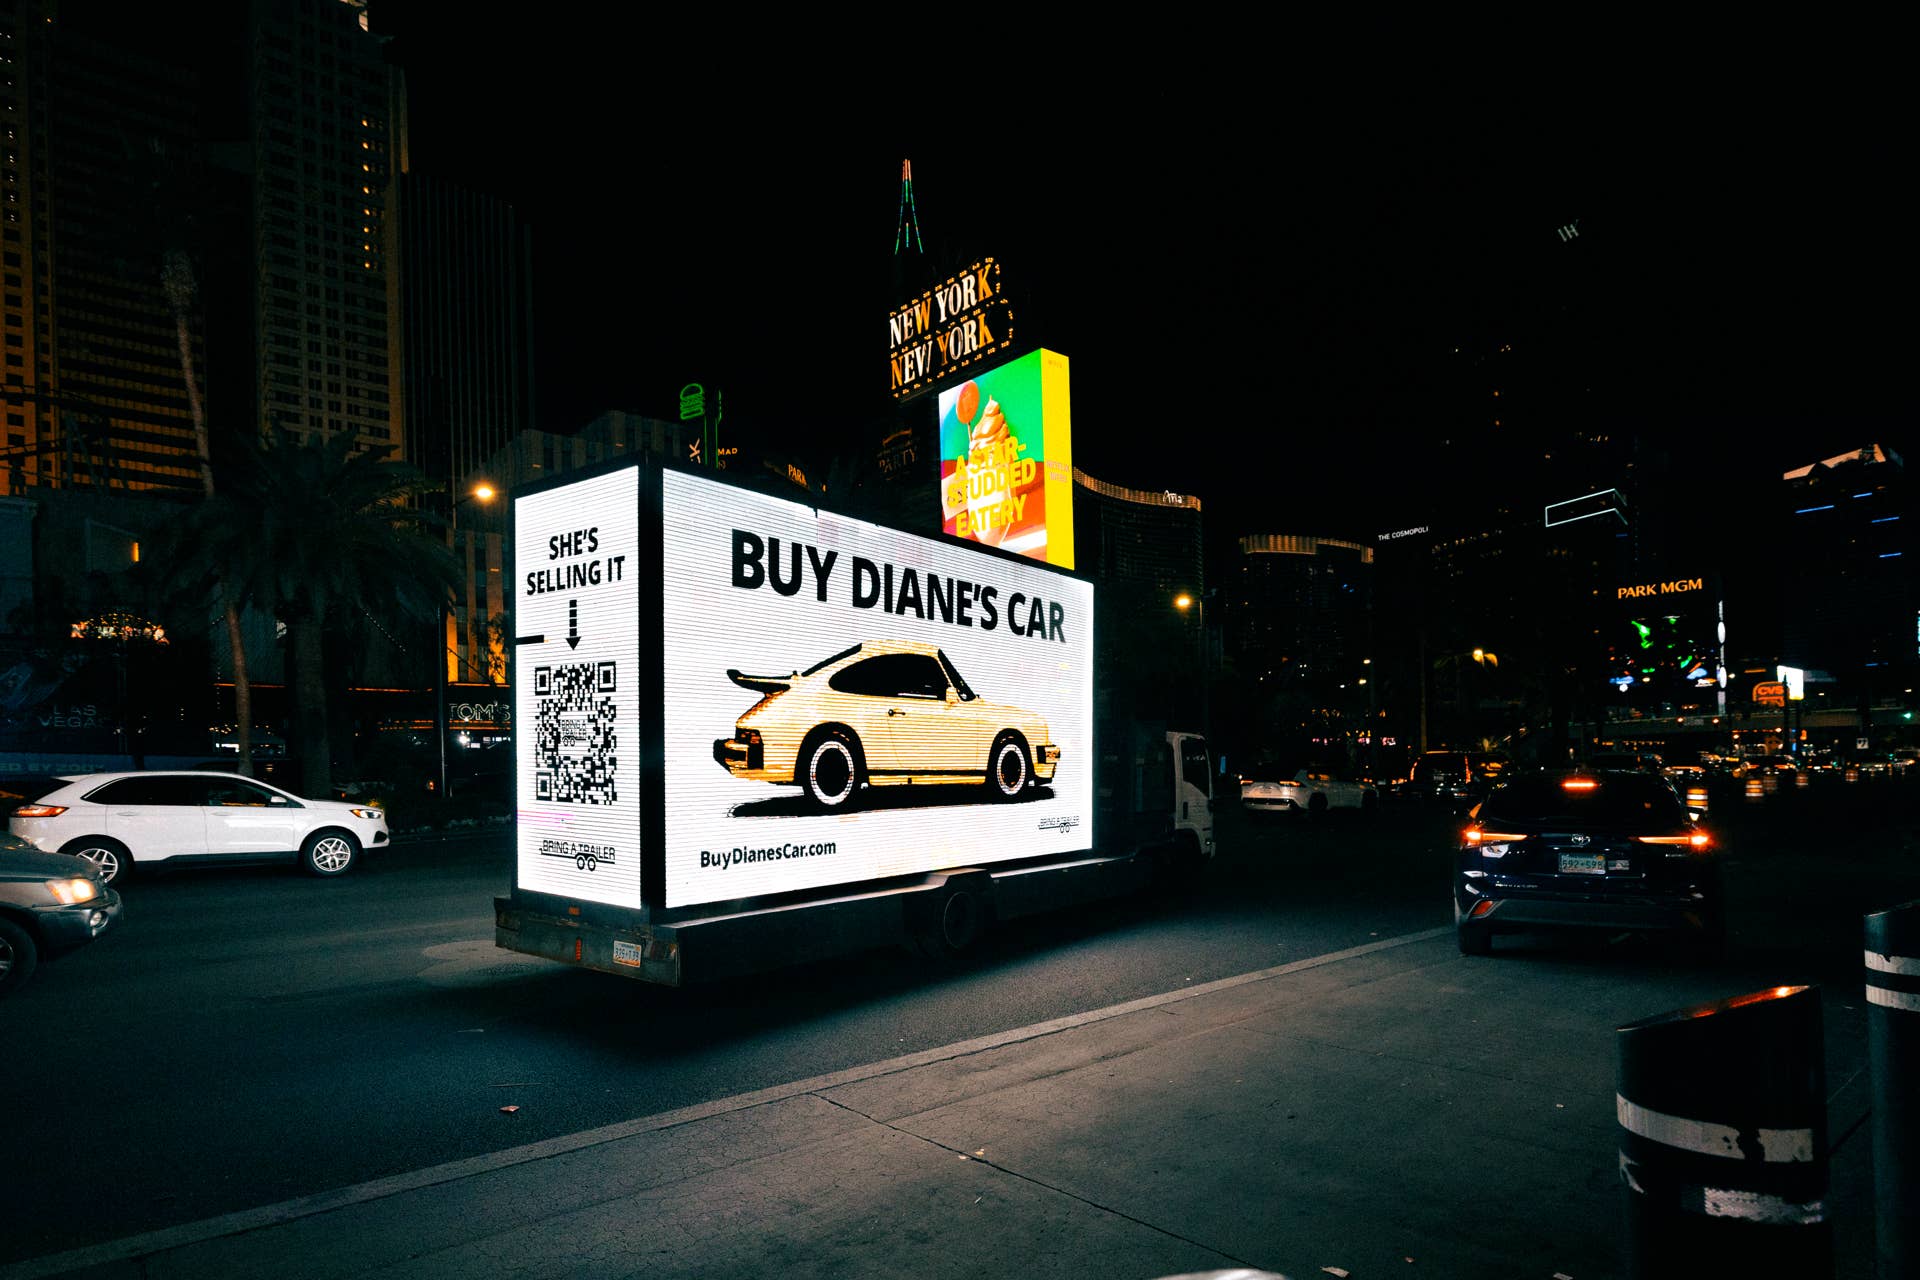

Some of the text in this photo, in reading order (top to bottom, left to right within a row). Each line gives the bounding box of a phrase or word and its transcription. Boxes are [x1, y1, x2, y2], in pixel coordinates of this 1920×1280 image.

[889, 263, 994, 349] NEW YORK
[890, 312, 995, 390] NEW YORK
[955, 436, 1027, 481] A STAR-
[947, 458, 1037, 508] STUDDED
[956, 494, 1028, 538] EATERY
[549, 527, 599, 561] SHE'S
[1378, 533, 1391, 541] THE
[526, 555, 626, 596] SELLING IT
[732, 528, 1067, 644] BUY DIANE'S CAR
[1617, 578, 1703, 599] PARK MGM
[448, 701, 511, 721] TOM'S
[542, 839, 616, 860] BRING A TRAILER
[700, 842, 837, 870] BuyDianesCar.com
